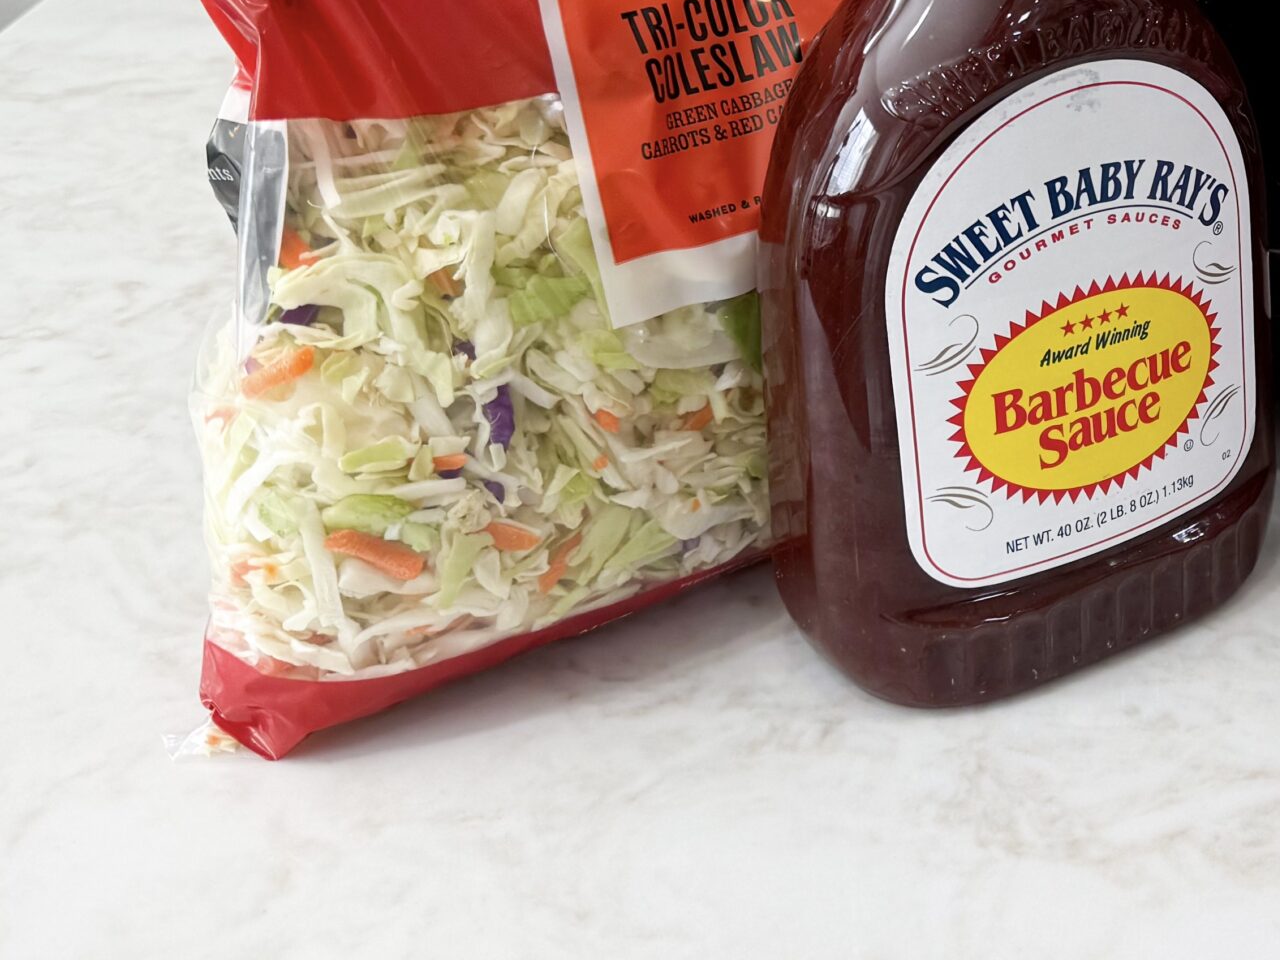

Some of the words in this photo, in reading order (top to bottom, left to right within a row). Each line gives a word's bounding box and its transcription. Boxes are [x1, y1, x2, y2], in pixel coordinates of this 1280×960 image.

[645, 21, 804, 103] COLESLAW
[641, 128, 711, 160] CARROTS
[714, 123, 728, 141] &
[730, 110, 764, 138] RED
[667, 101, 718, 130] GREEN
[688, 203, 736, 224] WASHED
[741, 199, 750, 209] &
[914, 189, 1040, 309] SWEET
[1044, 159, 1146, 220] BABY
[1147, 159, 1229, 227] RAY'S
[988, 218, 1094, 284] GOURMET
[1107, 212, 1181, 230] SAUCES
[1039, 341, 1089, 367] Award
[1095, 320, 1151, 351] Winning
[991, 340, 1193, 435] Barbecue
[1039, 391, 1162, 470] Sauce
[1005, 537, 1030, 554] NET
[1033, 529, 1055, 547] WT.
[1057, 523, 1073, 539] 40
[1075, 517, 1094, 535] OZ.
[1096, 511, 1108, 529] (2
[1110, 507, 1128, 523] LB.
[1130, 500, 1138, 513] 8
[1140, 490, 1160, 510] OZ.)
[1162, 474, 1195, 498] 1.13kg
